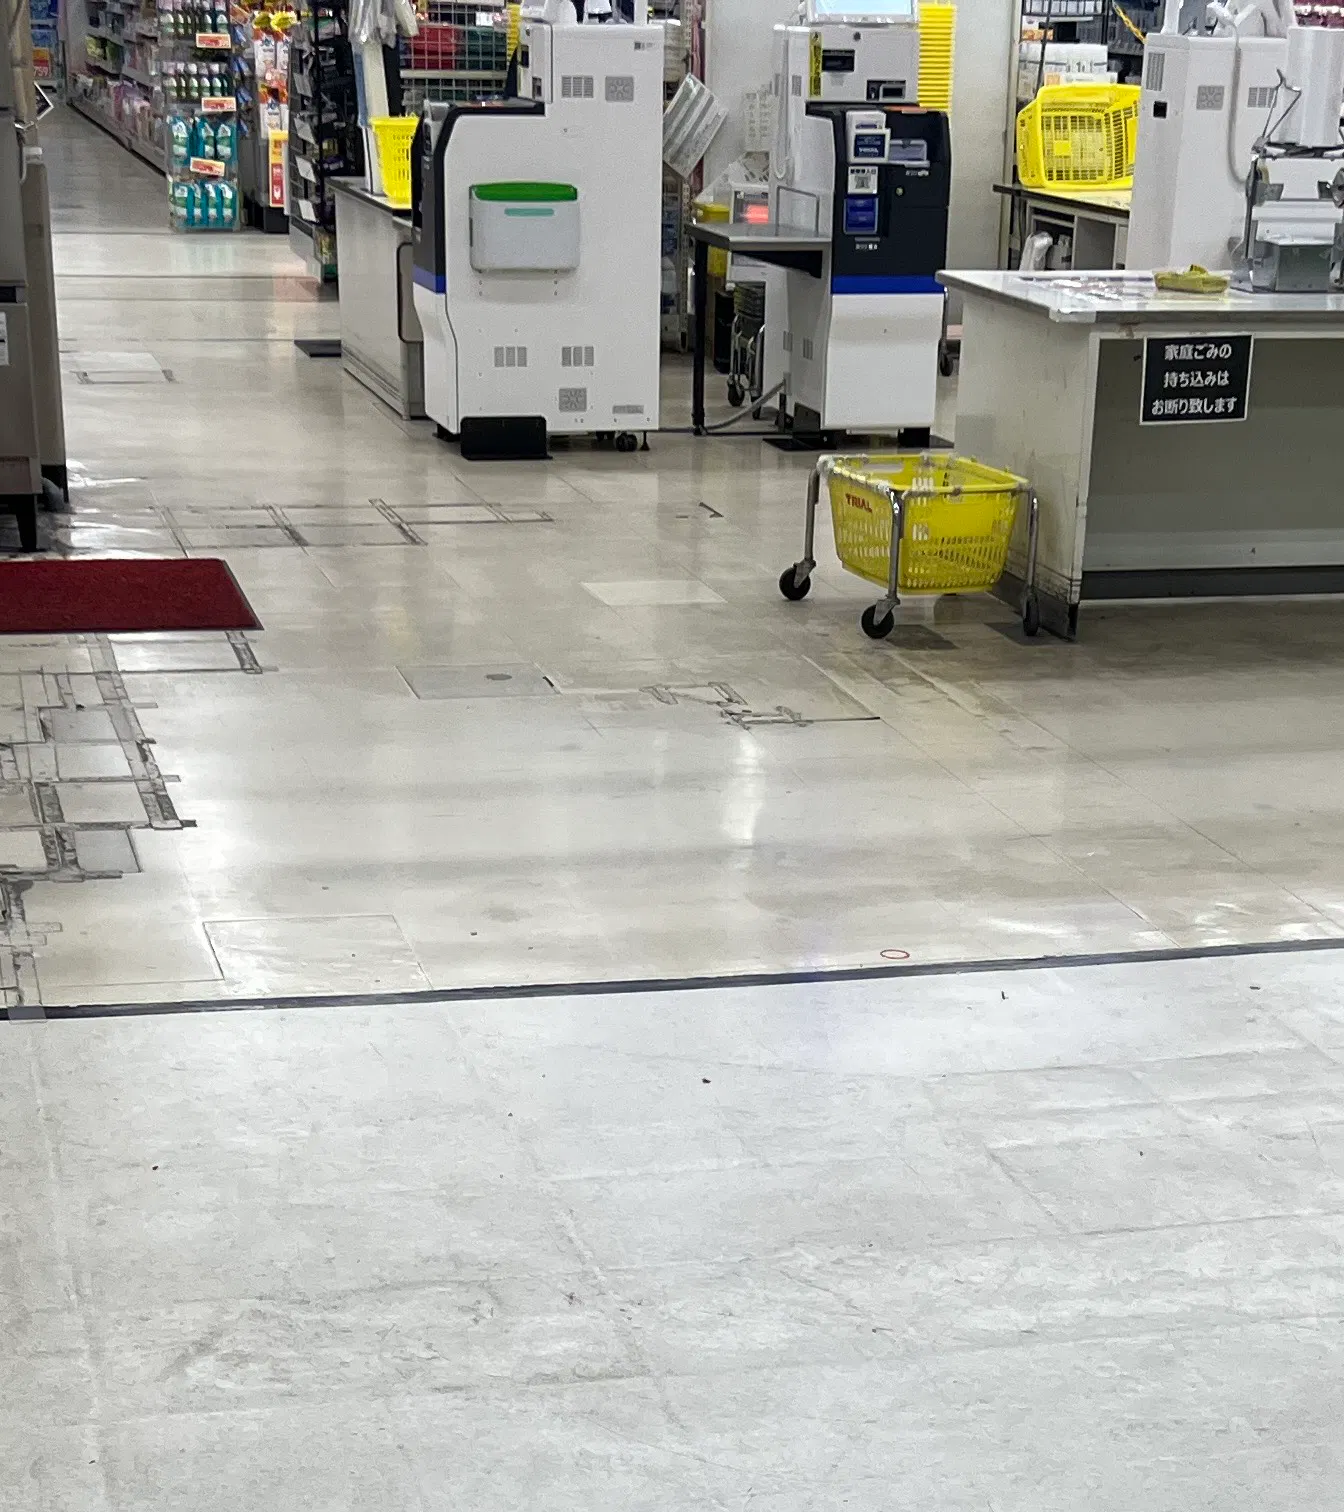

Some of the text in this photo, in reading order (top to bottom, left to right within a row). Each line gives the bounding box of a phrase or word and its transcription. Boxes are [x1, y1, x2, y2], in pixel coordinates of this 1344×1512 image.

[1164, 343, 1232, 360] 家庭ごみの
[1163, 370, 1230, 388] 持ち込みは
[1151, 397, 1237, 415] お断り致します
[845, 493, 873, 513] TRIAL
